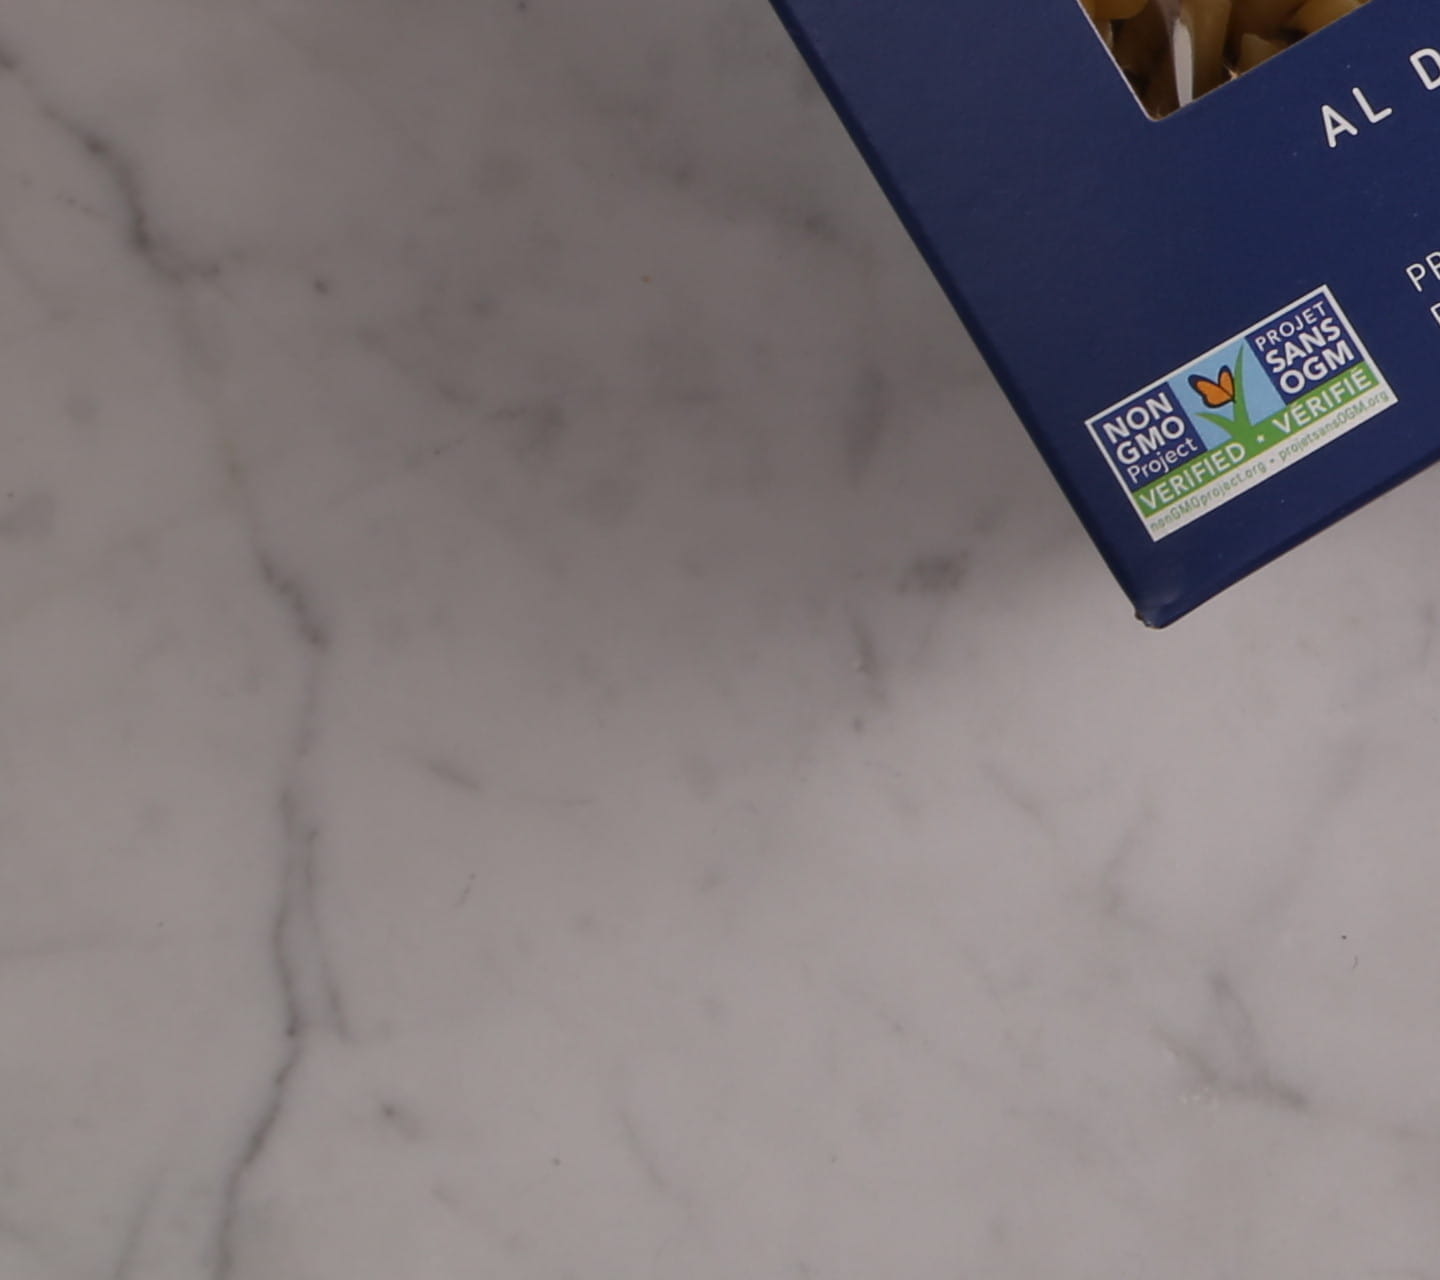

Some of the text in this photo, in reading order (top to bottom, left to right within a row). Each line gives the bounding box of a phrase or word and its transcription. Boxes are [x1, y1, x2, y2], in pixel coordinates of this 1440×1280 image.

[1322, 88, 1392, 147] AL
[1255, 301, 1328, 352] PROJET
[1265, 317, 1341, 373] SANS
[1280, 343, 1355, 395] OGM
[1102, 393, 1175, 444] NON
[1116, 415, 1186, 465] GMO
[1139, 366, 1373, 511] VERIFIED VÉRIFIÉ
[1126, 437, 1198, 483] Project
